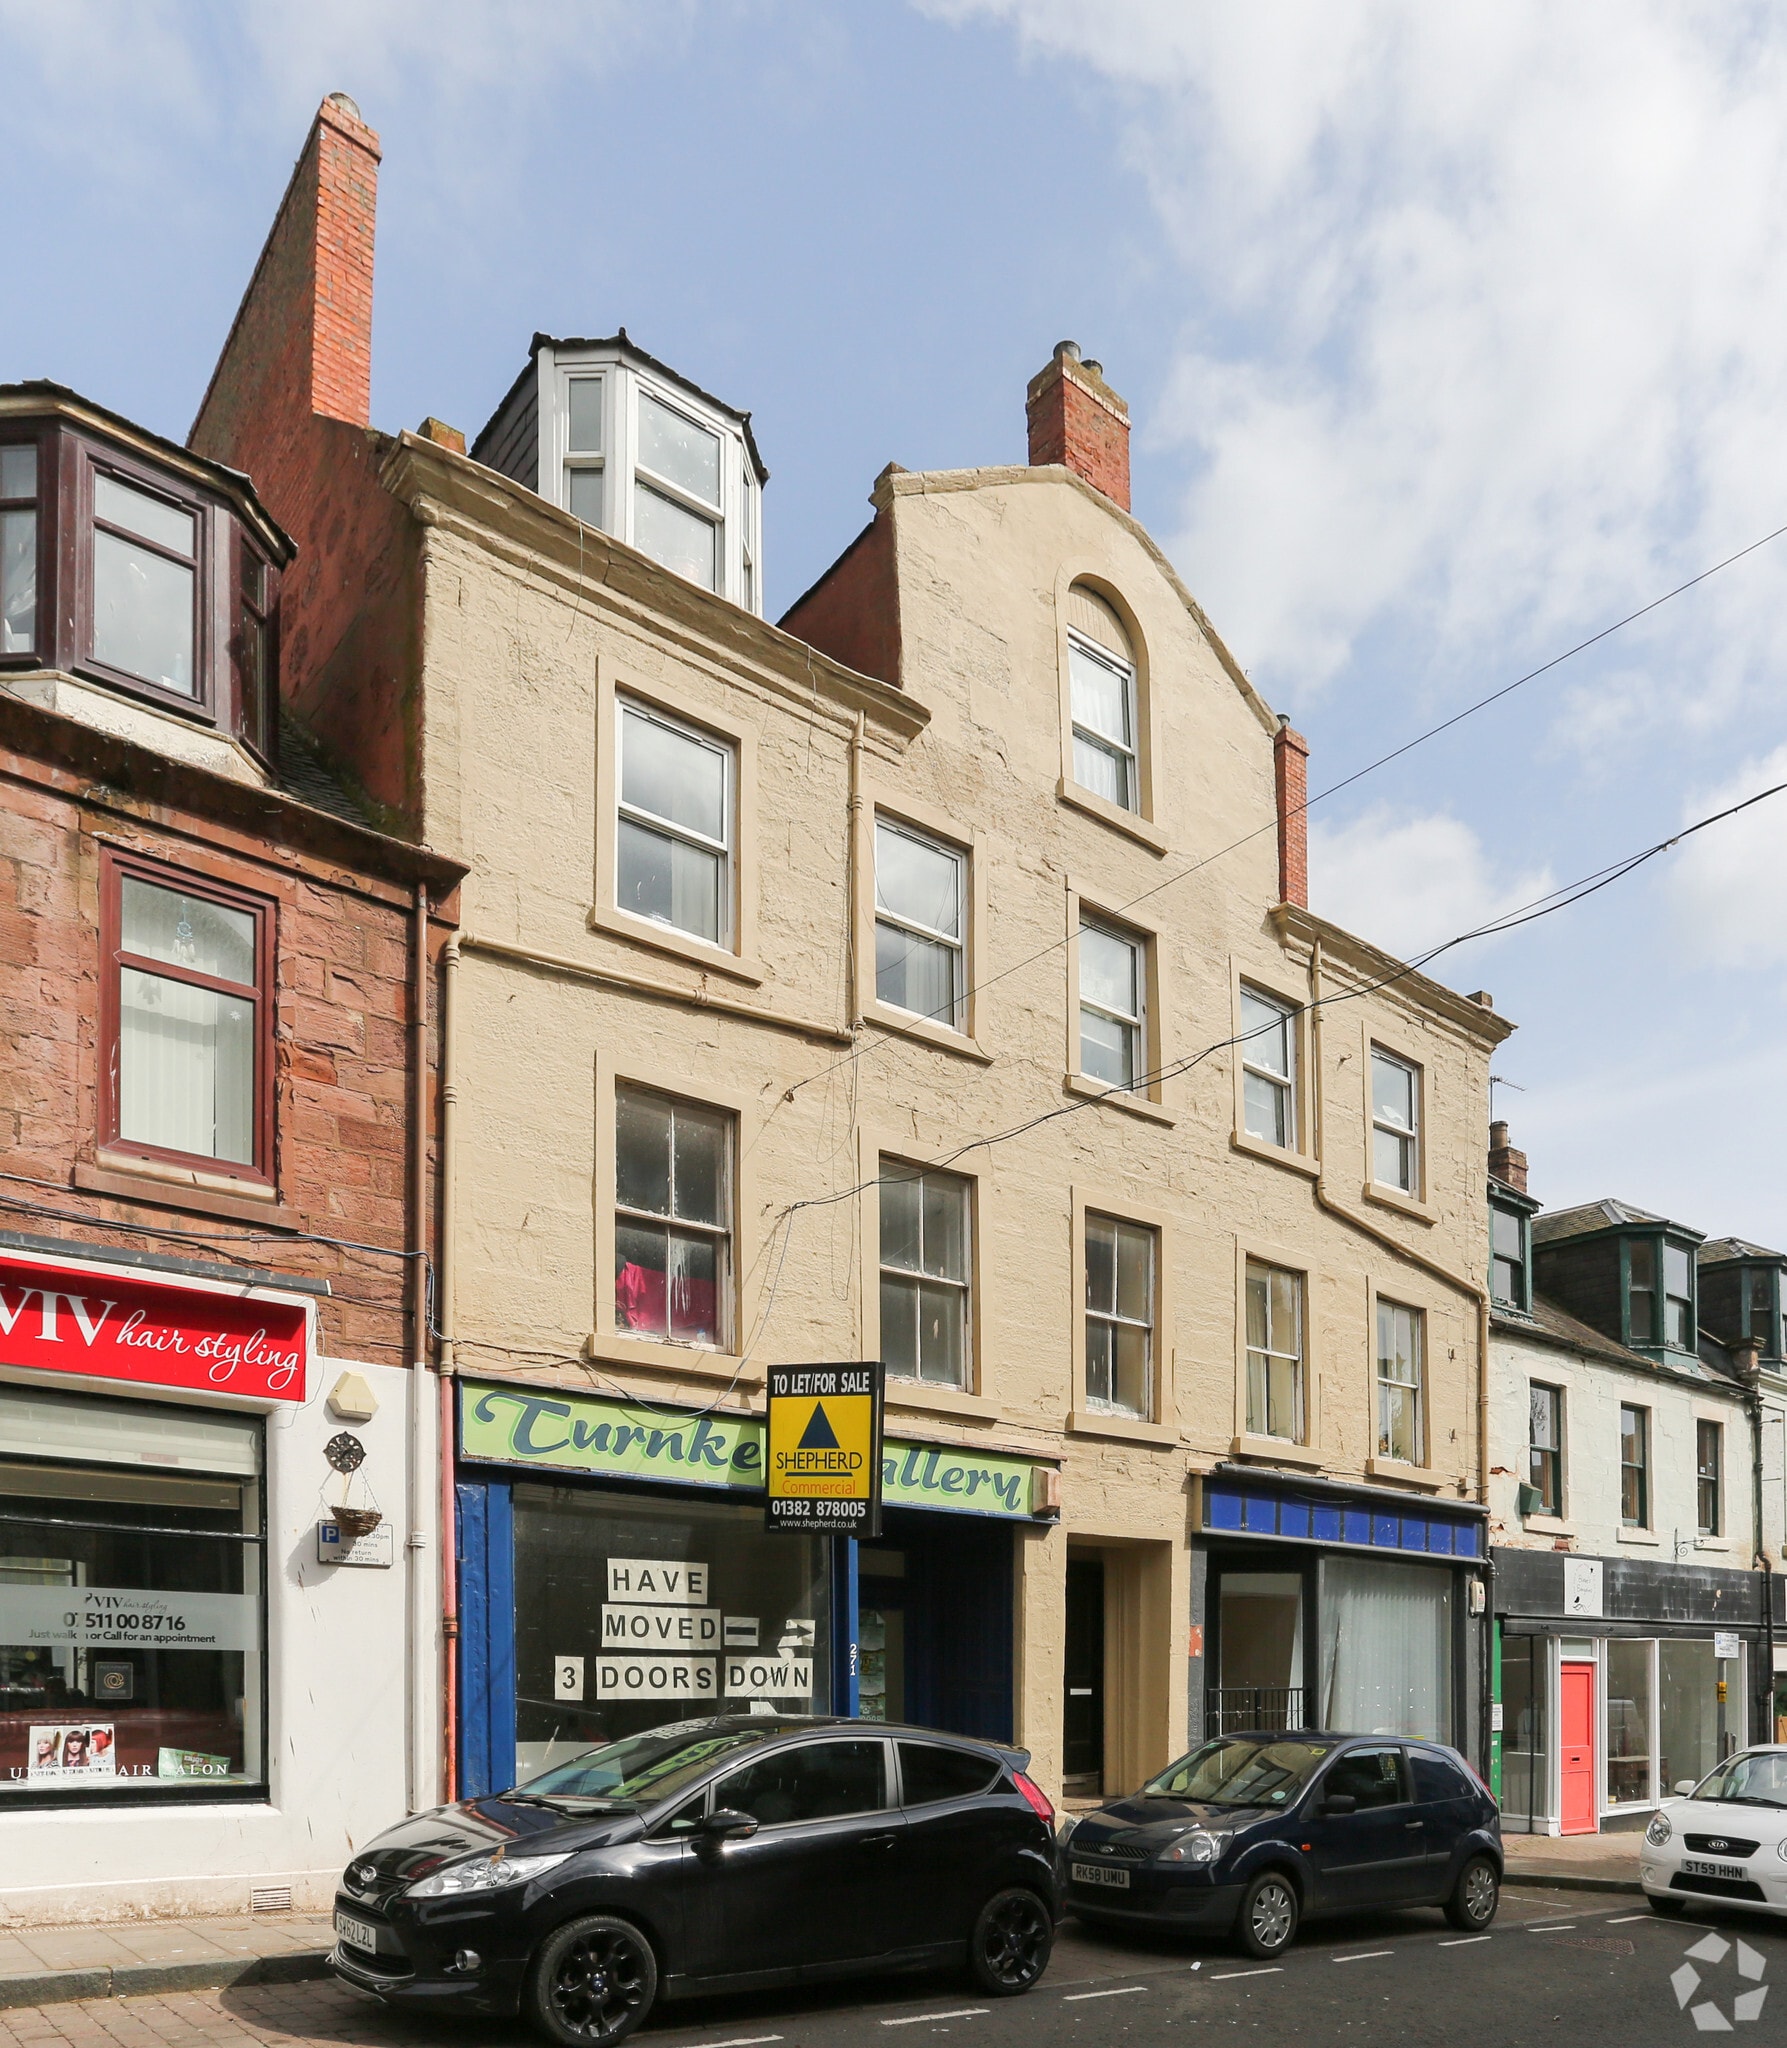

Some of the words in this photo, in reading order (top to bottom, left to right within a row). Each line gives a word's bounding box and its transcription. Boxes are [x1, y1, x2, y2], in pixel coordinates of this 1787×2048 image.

[0, 1283, 118, 1347] VIV
[115, 1309, 191, 1354] hair
[194, 1328, 299, 1391] styling
[773, 1374, 788, 1394] TO
[791, 1373, 836, 1394] LET/FOR
[840, 1372, 870, 1393] SALE
[475, 1391, 763, 1470] Turnke
[881, 1446, 1021, 1511] allery
[776, 1452, 863, 1470] SHEPHERD
[782, 1480, 856, 1495] Commercial
[772, 1500, 811, 1516] 01382
[816, 1502, 866, 1517] 878005
[780, 1519, 857, 1530] www.shepherd.co.uk
[613, 1569, 702, 1594] HAVE
[93, 1596, 124, 1609] VIV
[63, 1612, 112, 1629] 0511
[605, 1614, 716, 1640] MOVED
[28, 1629, 50, 1639] Just
[52, 1630, 77, 1640] walk
[90, 1633, 102, 1641] or
[103, 1631, 122, 1641] Call
[123, 1632, 138, 1641] for
[140, 1634, 152, 1642] an
[153, 1633, 216, 1644] appointment
[562, 1666, 576, 1689] 3
[601, 1666, 711, 1689] DOORS
[729, 1665, 808, 1688] DOWN
[118, 1764, 153, 1776] AIR
[176, 1764, 228, 1776] ALON
[1076, 1865, 1101, 1881] RK58
[1685, 1861, 1716, 1875] ST59
[1718, 1866, 1743, 1879] HHN
